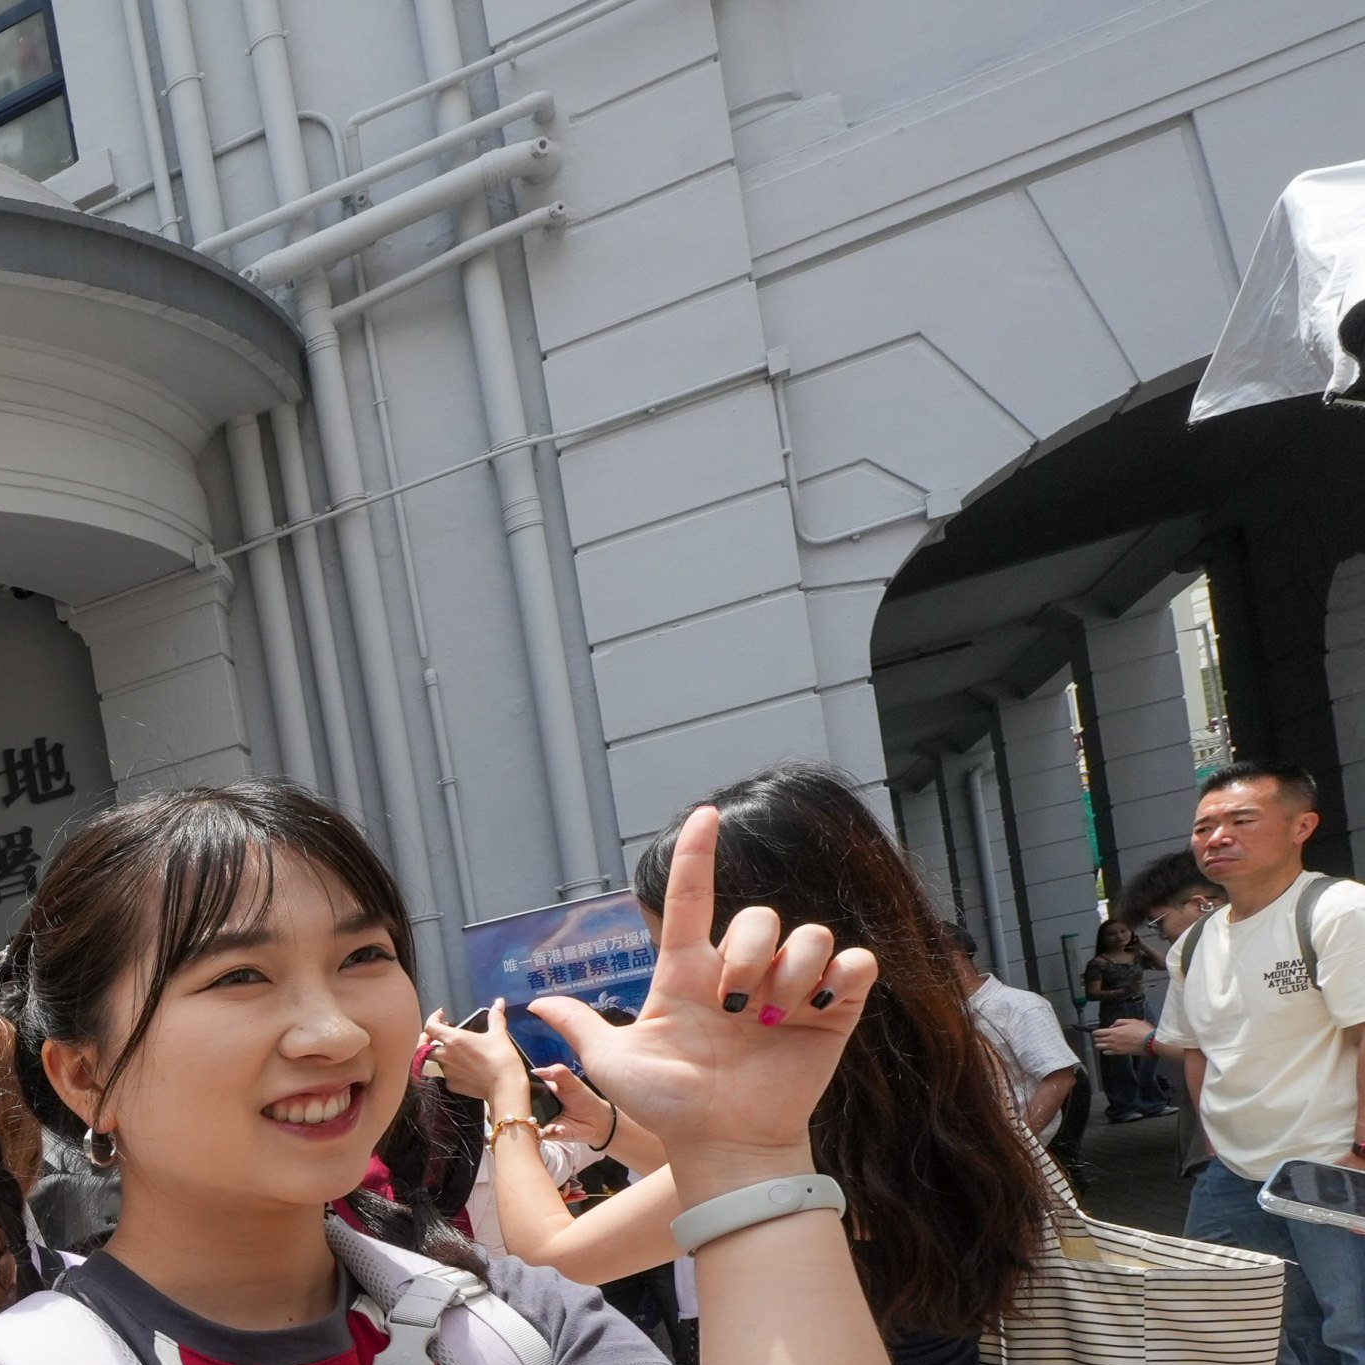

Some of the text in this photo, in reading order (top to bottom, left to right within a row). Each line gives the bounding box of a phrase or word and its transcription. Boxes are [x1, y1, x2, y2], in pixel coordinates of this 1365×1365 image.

[527, 947, 657, 990] 香港警察禮品
[1263, 967, 1310, 980] MOUNT
[573, 979, 594, 988] POLICE
[596, 974, 616, 983] FORCE
[617, 967, 648, 979] SOUVENIR
[1278, 983, 1309, 995] CLUB
